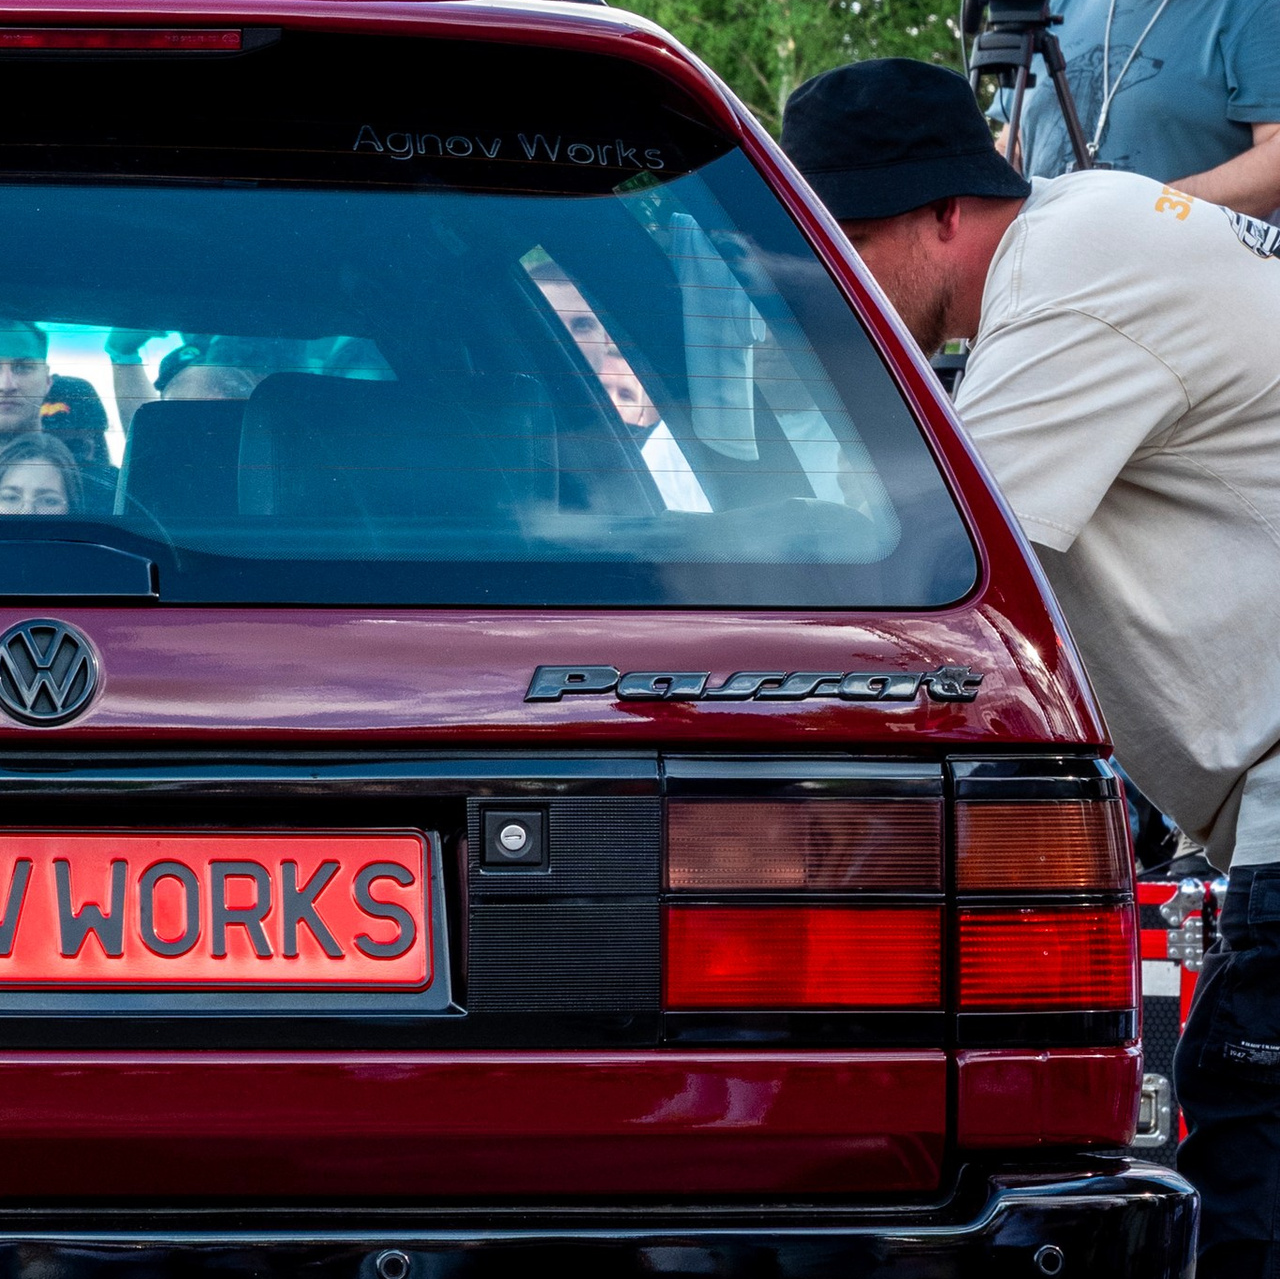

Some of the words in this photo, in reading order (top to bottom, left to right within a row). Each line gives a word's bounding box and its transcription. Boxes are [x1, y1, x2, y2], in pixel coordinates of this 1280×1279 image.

[352, 124, 502, 160] Agnov
[517, 132, 665, 169] Works
[523, 664, 985, 703] Passat
